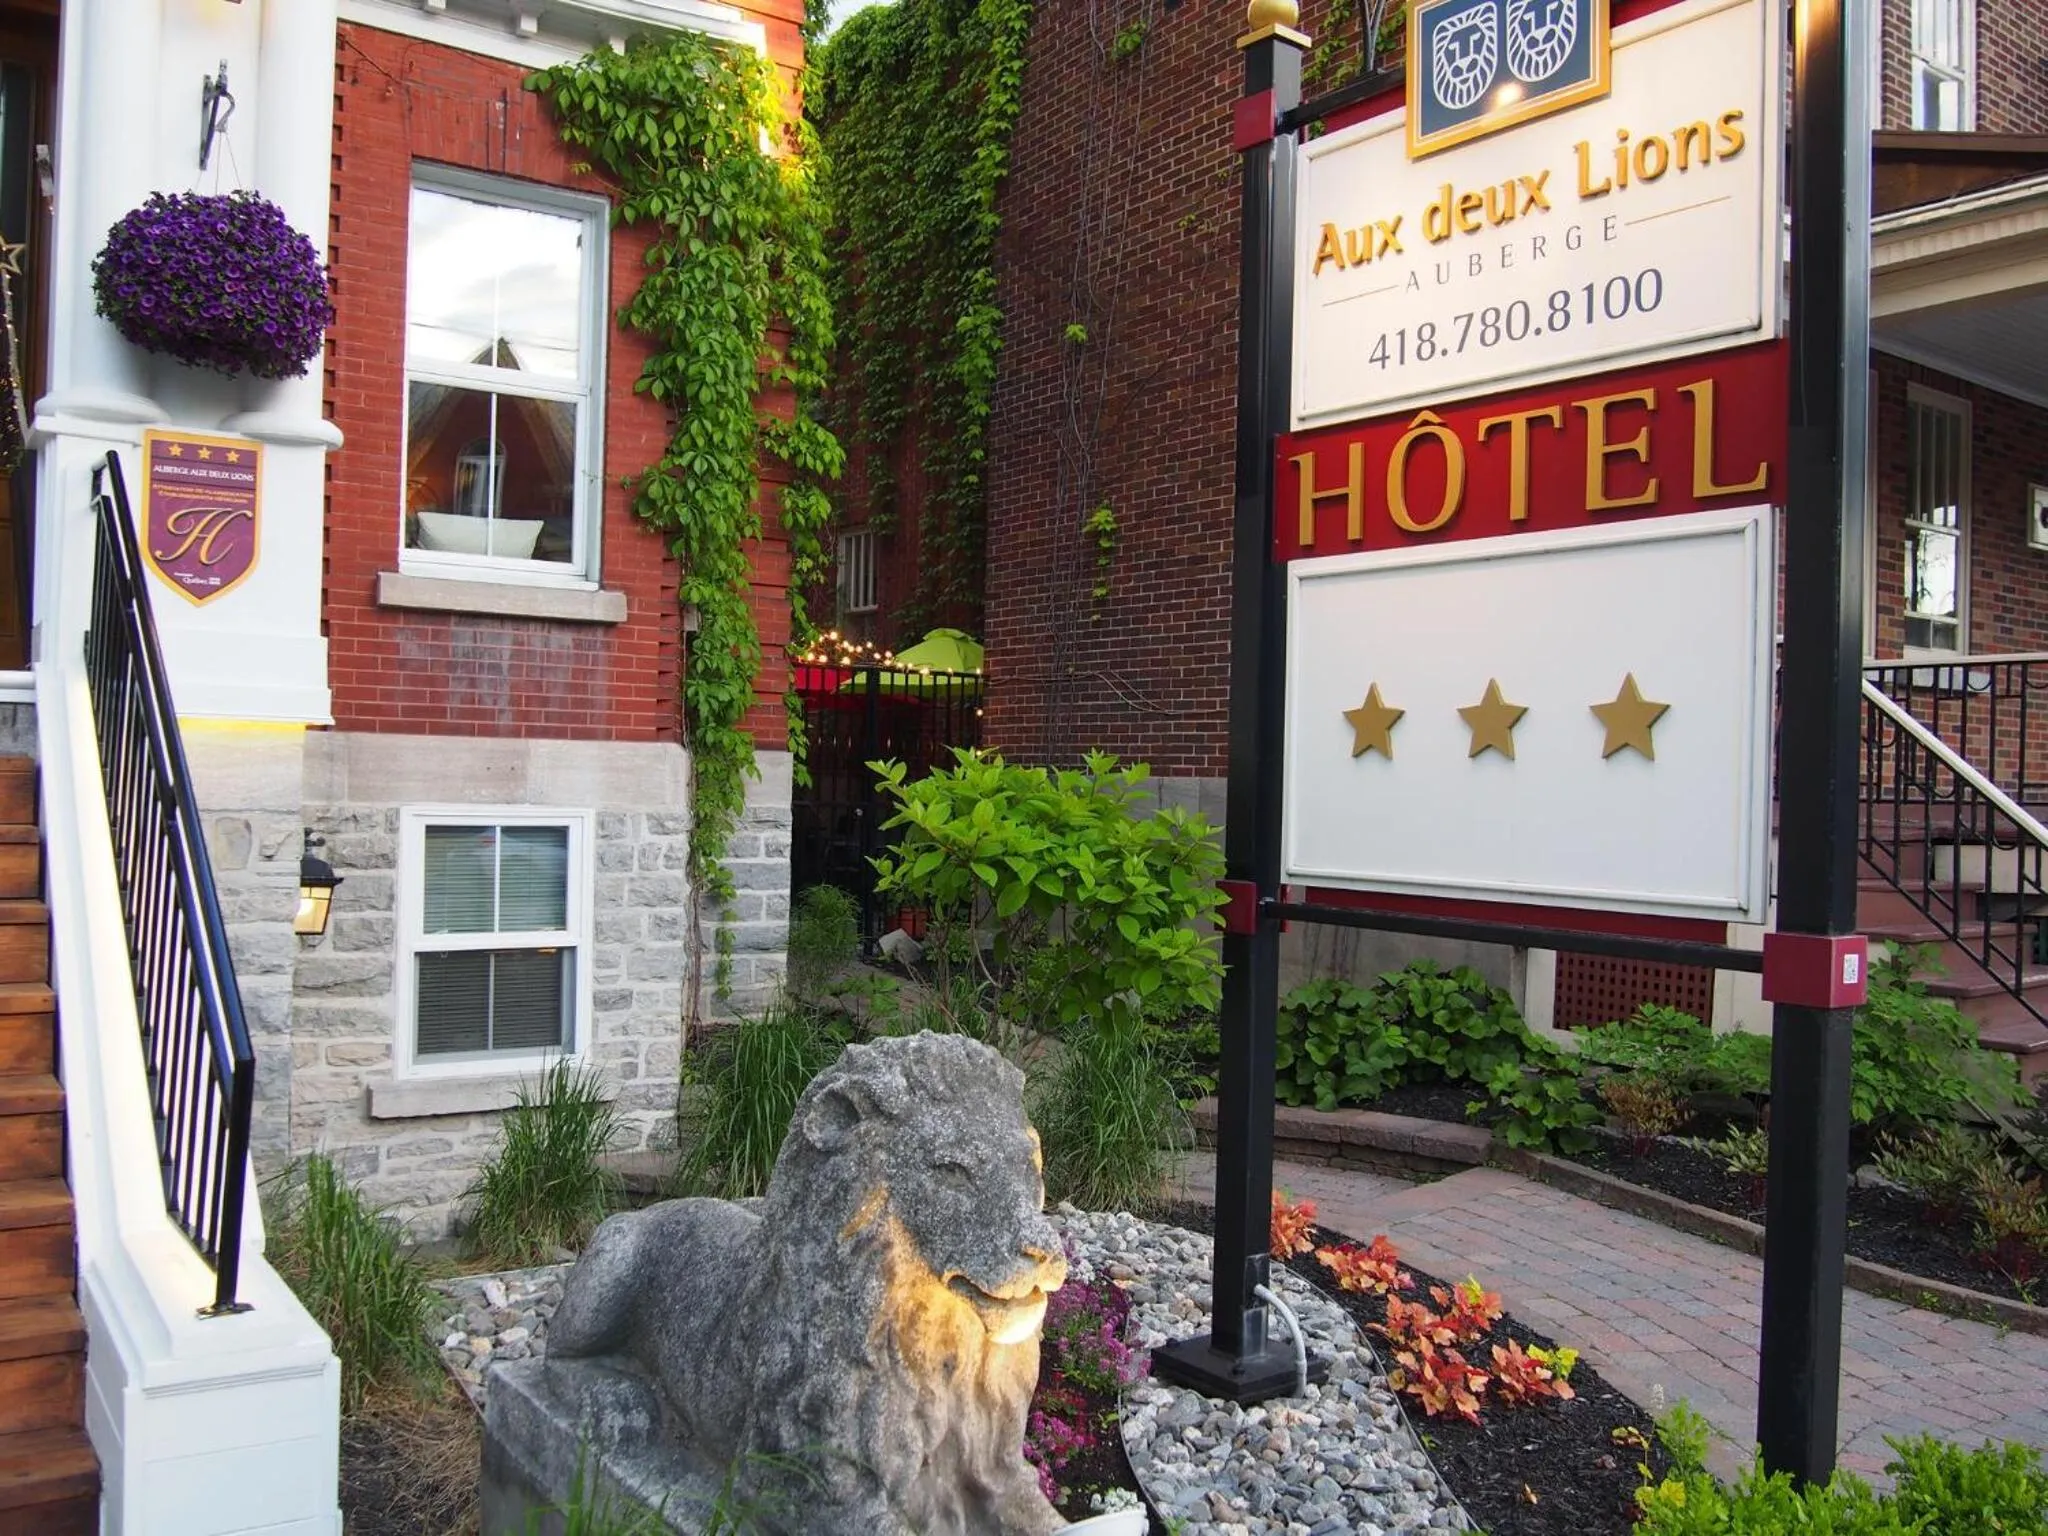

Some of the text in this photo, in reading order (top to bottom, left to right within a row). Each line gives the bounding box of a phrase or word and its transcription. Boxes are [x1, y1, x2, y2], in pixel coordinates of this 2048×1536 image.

[1312, 109, 1746, 277] Aux deux Lions
[1406, 216, 1618, 293] AUBERGE
[1369, 268, 1664, 370] 418.780.8100
[1289, 379, 1768, 546] HÔTEL
